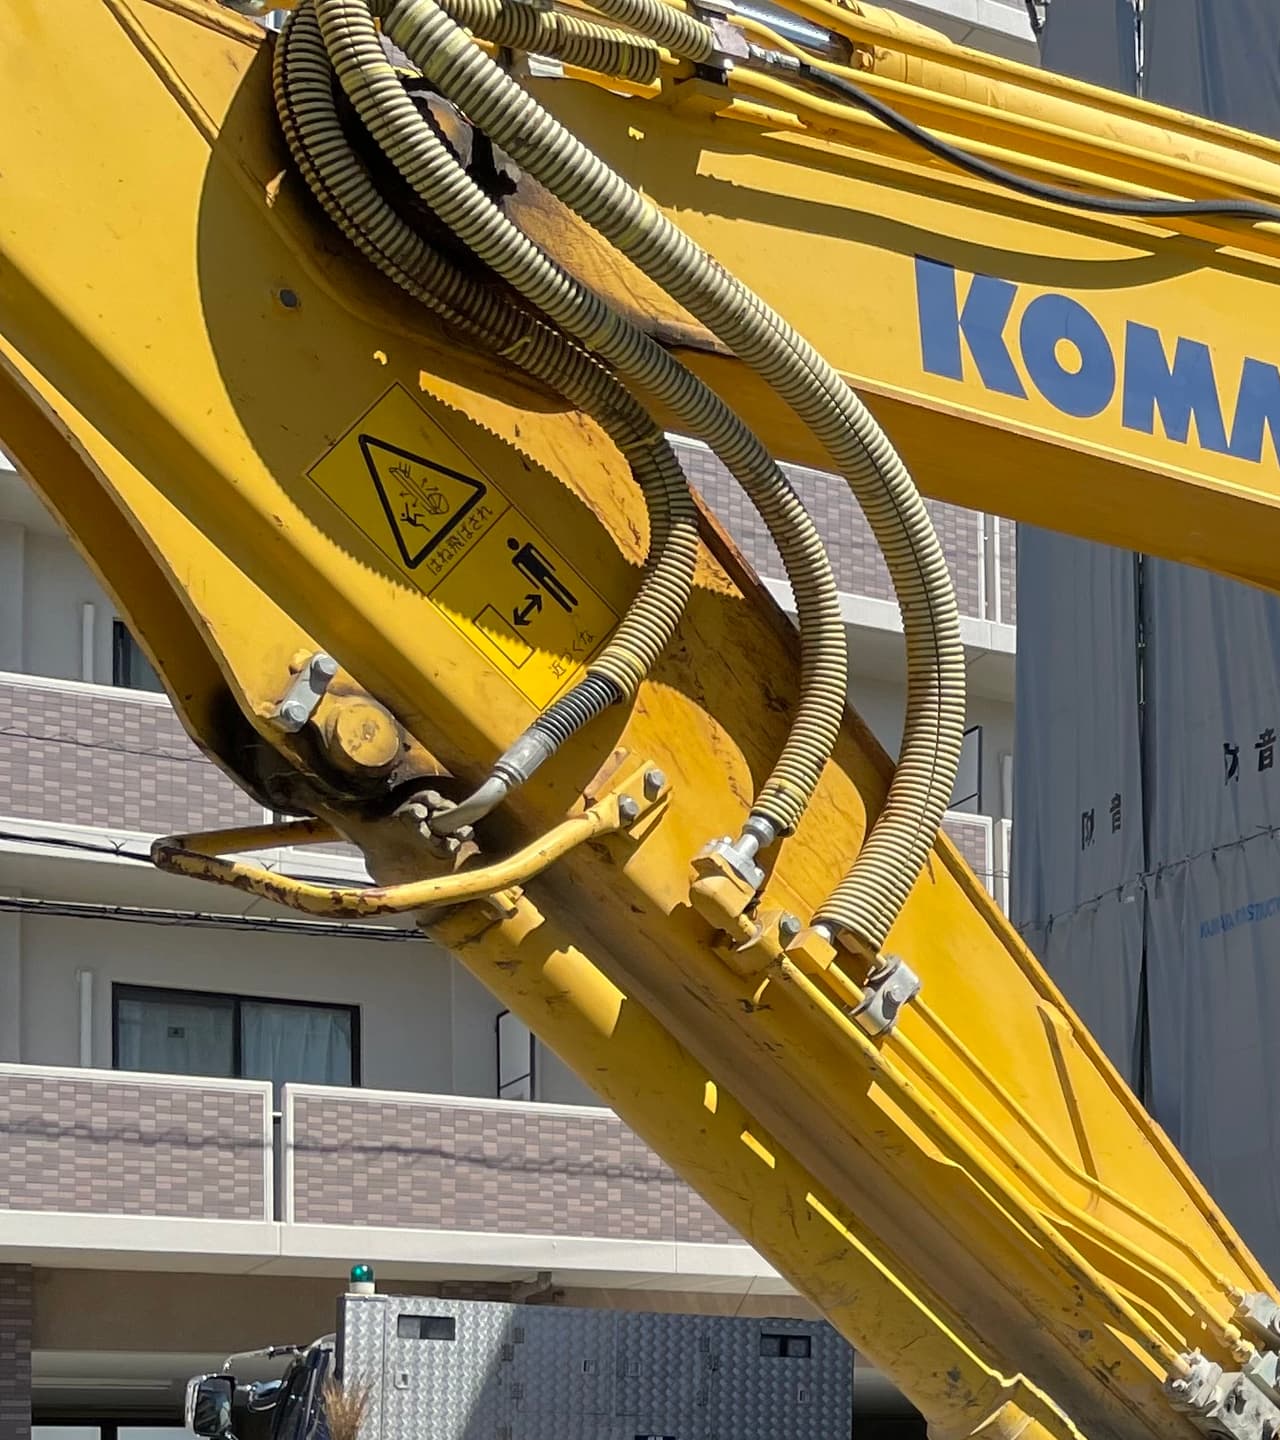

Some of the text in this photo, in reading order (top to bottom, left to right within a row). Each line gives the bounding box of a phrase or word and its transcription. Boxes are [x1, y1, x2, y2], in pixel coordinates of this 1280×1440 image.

[426, 503, 494, 576] はね飛ばされ
